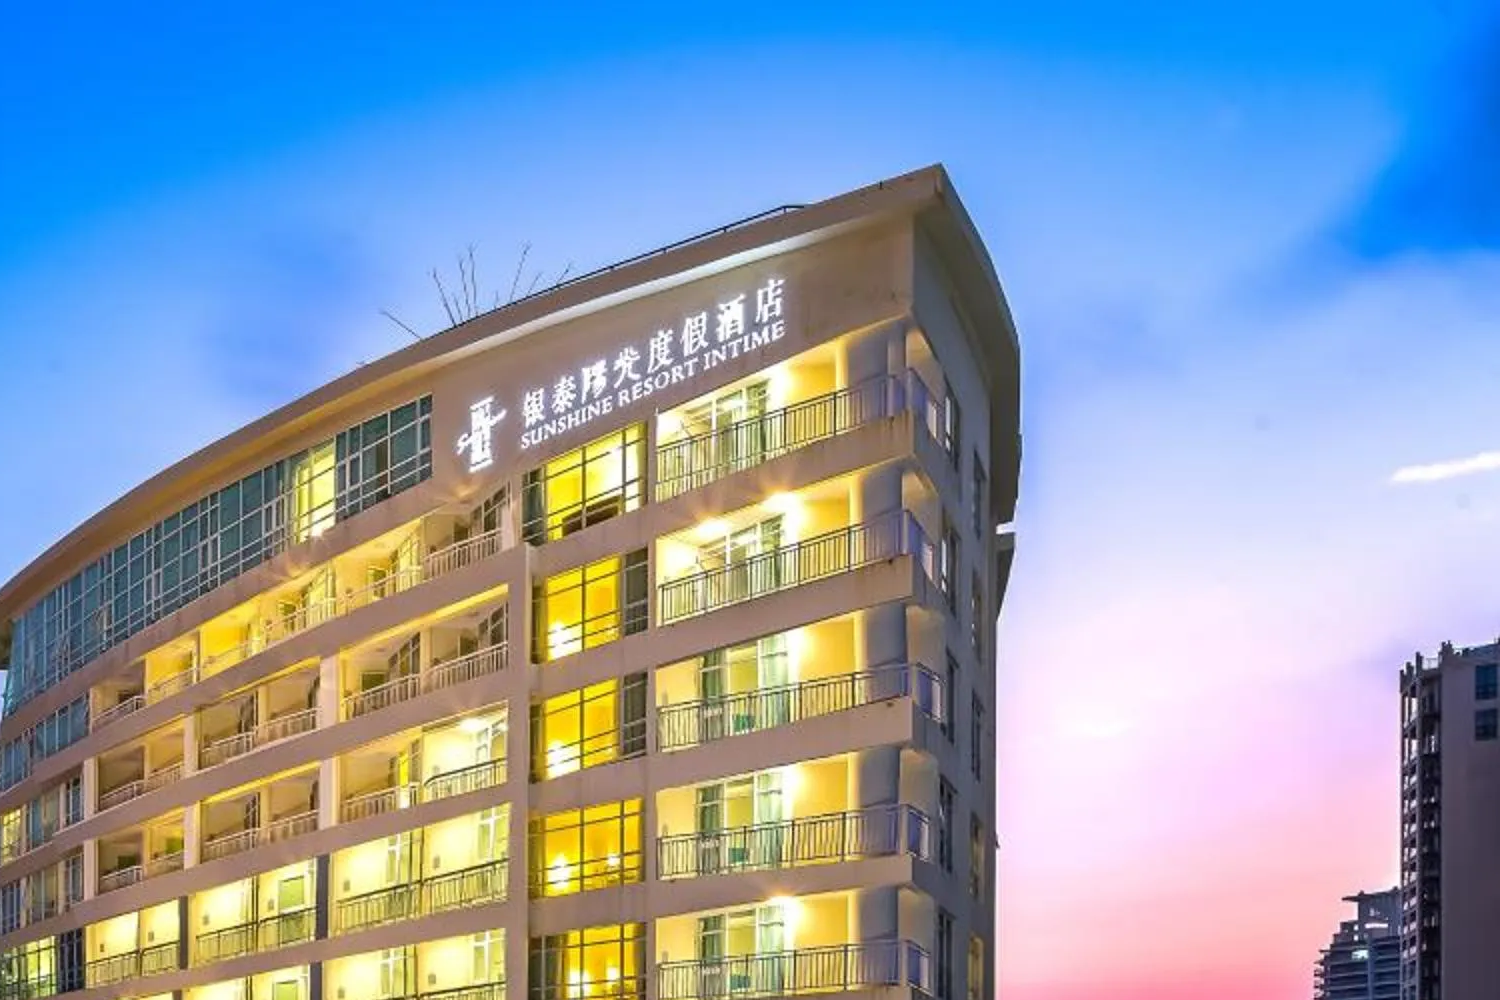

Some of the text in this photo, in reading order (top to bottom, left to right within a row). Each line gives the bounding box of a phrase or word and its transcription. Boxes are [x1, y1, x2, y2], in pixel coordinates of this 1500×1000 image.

[520, 319, 786, 450] SUNSHINE RESORT INTIME
